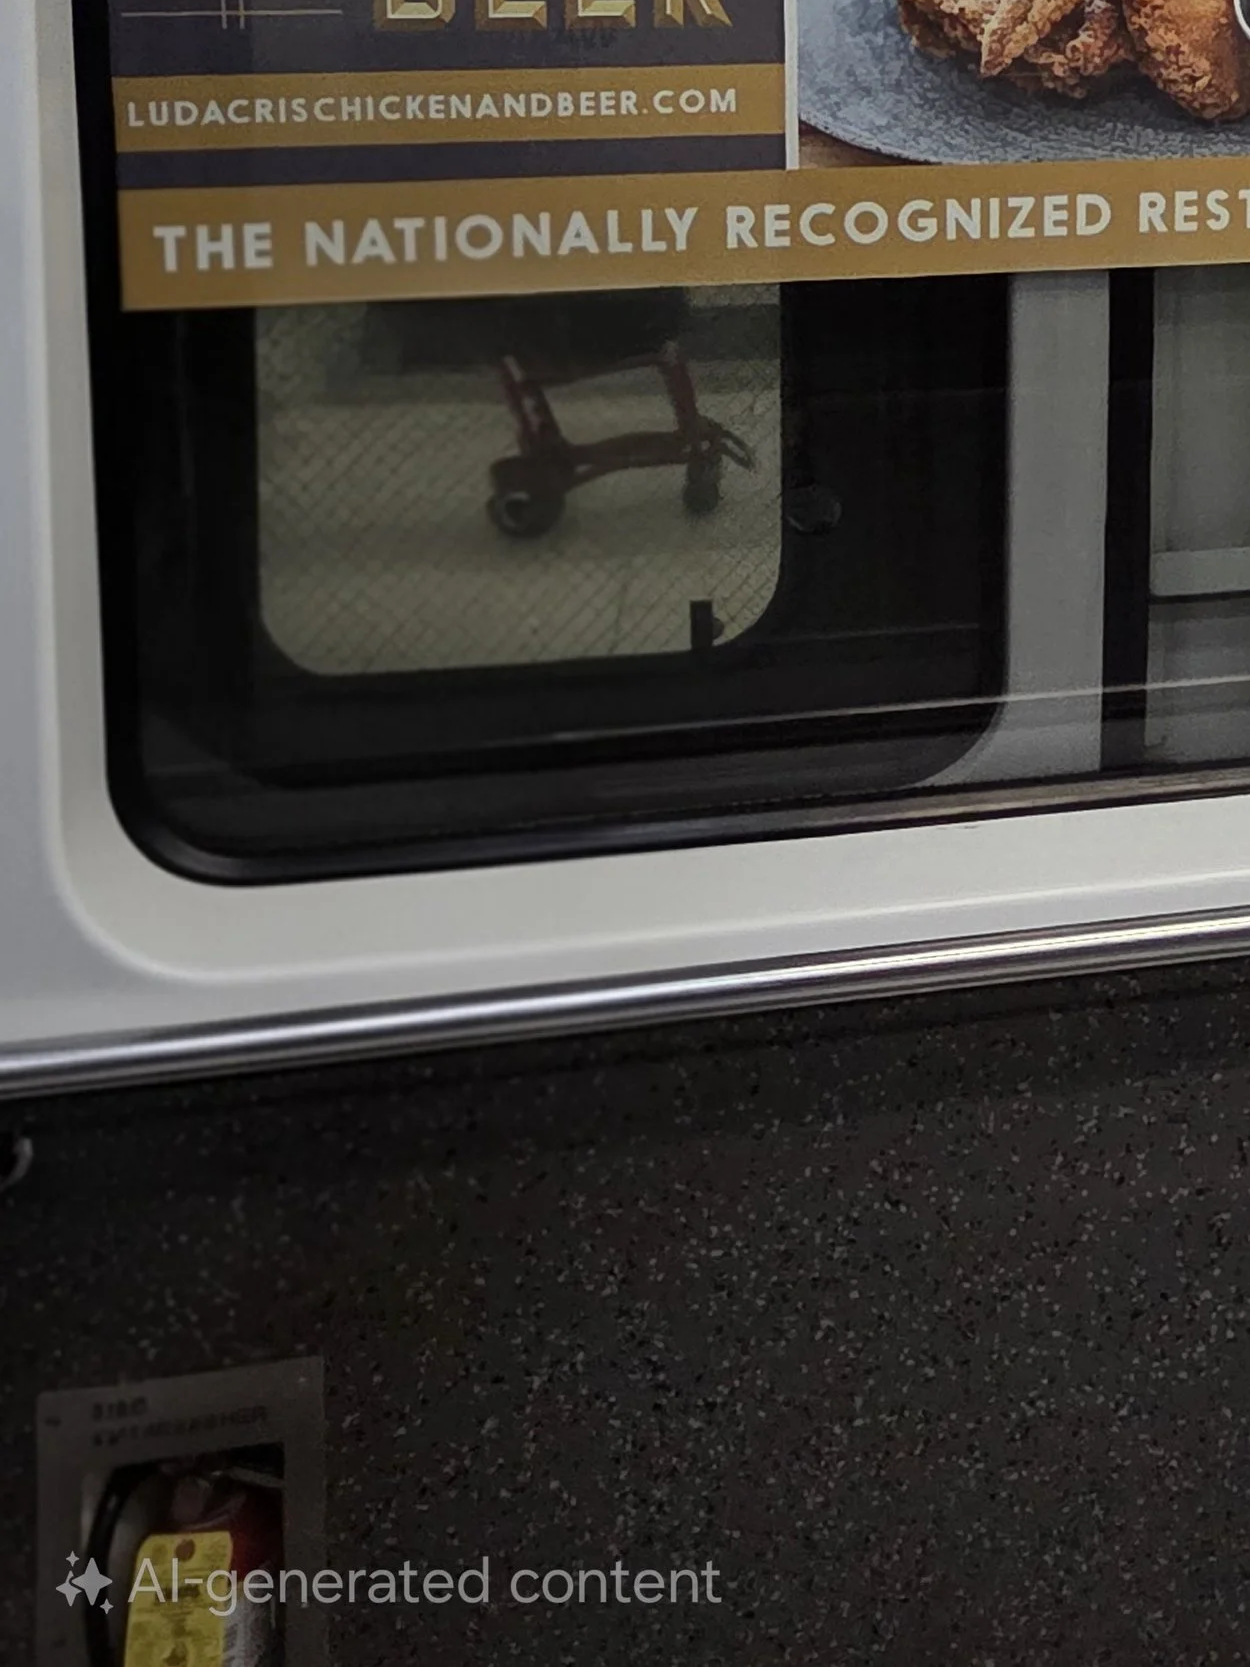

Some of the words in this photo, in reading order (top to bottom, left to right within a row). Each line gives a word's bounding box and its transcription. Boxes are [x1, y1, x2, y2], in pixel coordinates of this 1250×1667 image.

[126, 87, 738, 128] LUDACRISCHICKENANDBEER.COM
[153, 221, 274, 273] THE
[305, 205, 699, 267] NATIONALLY
[725, 192, 1112, 251] RECOGNIZED
